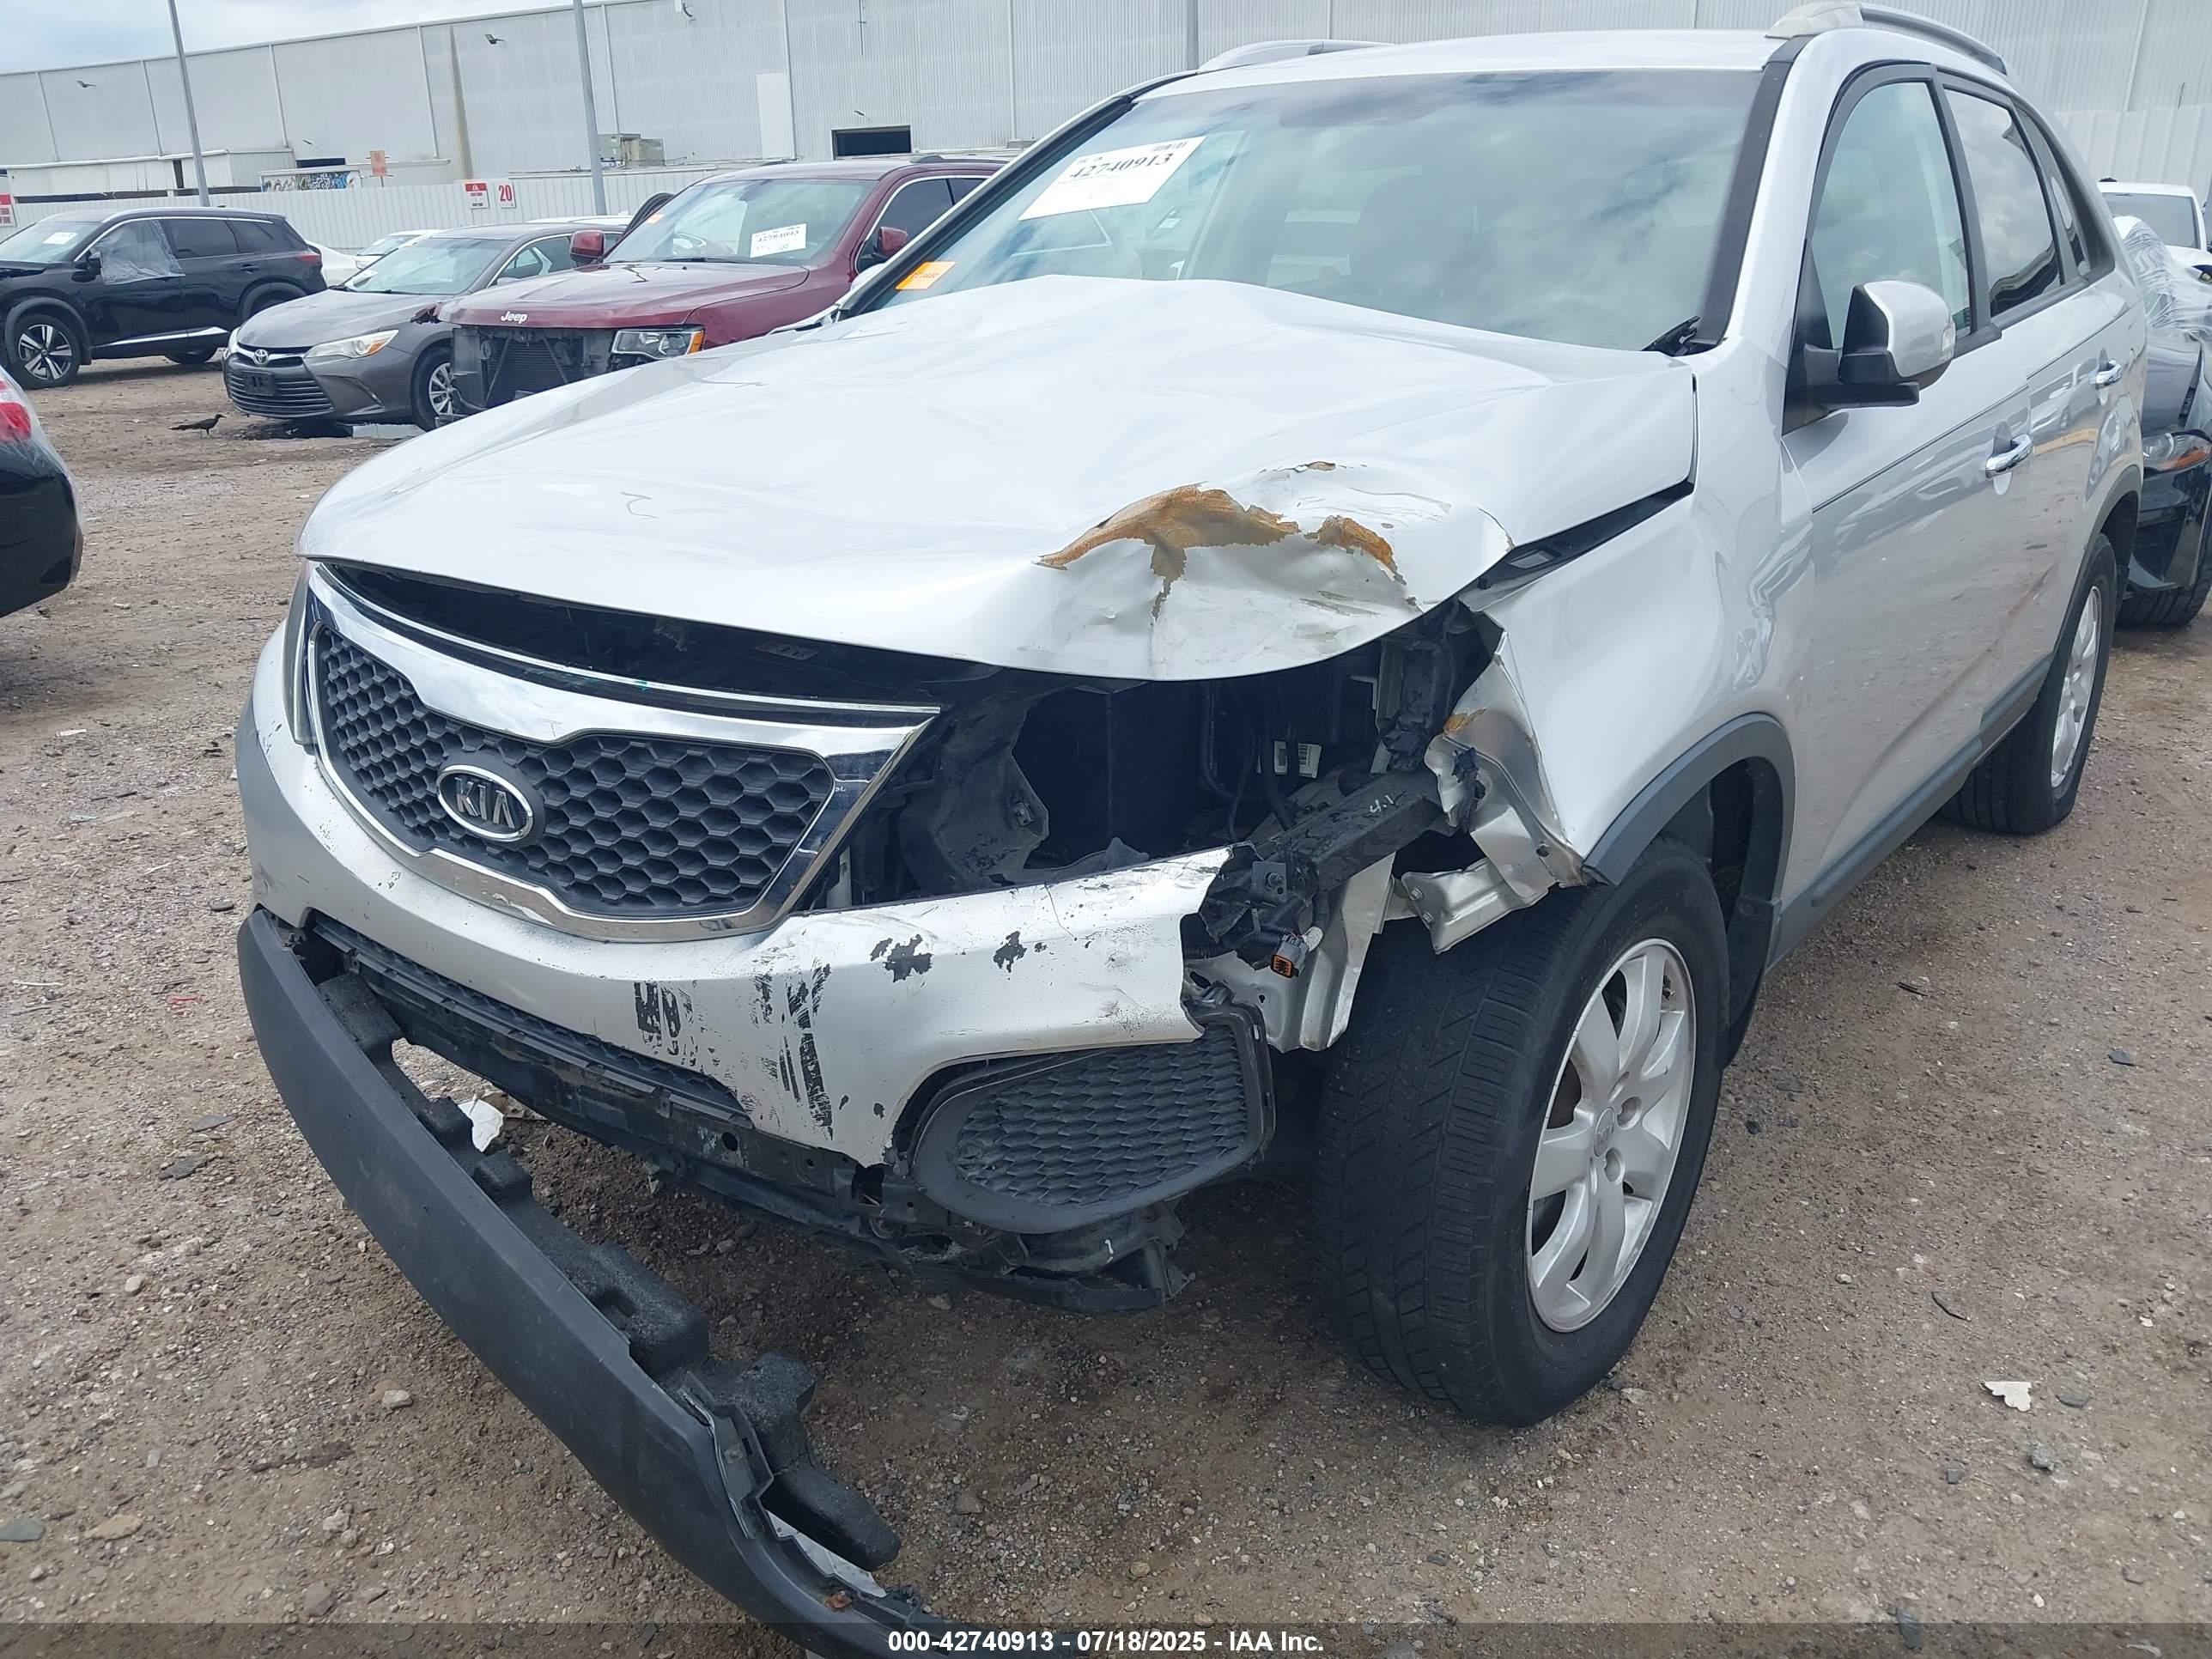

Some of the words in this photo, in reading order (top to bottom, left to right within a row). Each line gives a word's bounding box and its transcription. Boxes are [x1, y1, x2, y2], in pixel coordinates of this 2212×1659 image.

[1071, 152, 1174, 178] 42740913
[498, 185, 513, 202] 20
[501, 310, 527, 325] Jeep
[454, 776, 515, 830] KIA
